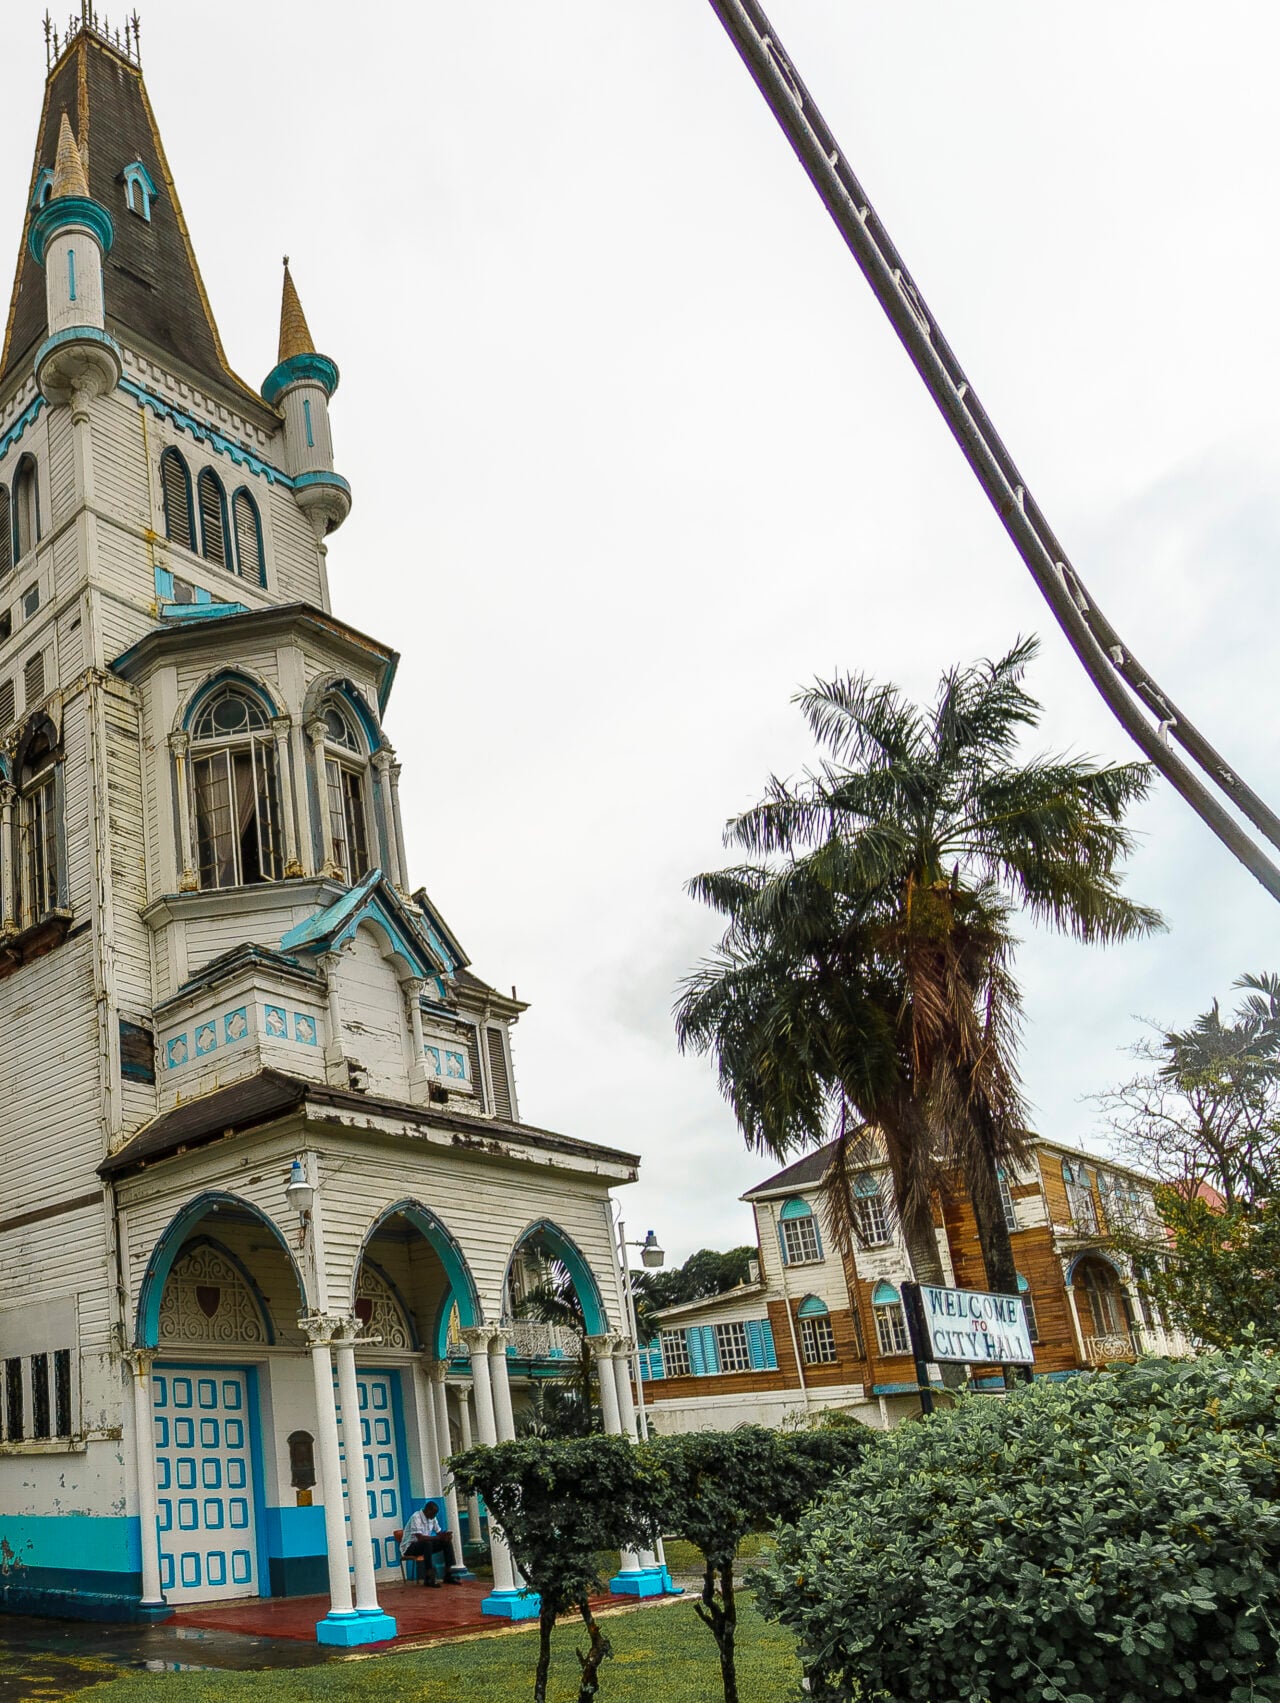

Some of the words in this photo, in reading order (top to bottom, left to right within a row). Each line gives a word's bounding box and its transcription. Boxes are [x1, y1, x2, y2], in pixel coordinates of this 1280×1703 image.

[929, 1290, 1017, 1323] WELCOME
[972, 1319, 988, 1332] TO
[934, 1329, 979, 1357] CITY
[983, 1333, 1030, 1359] HALL
